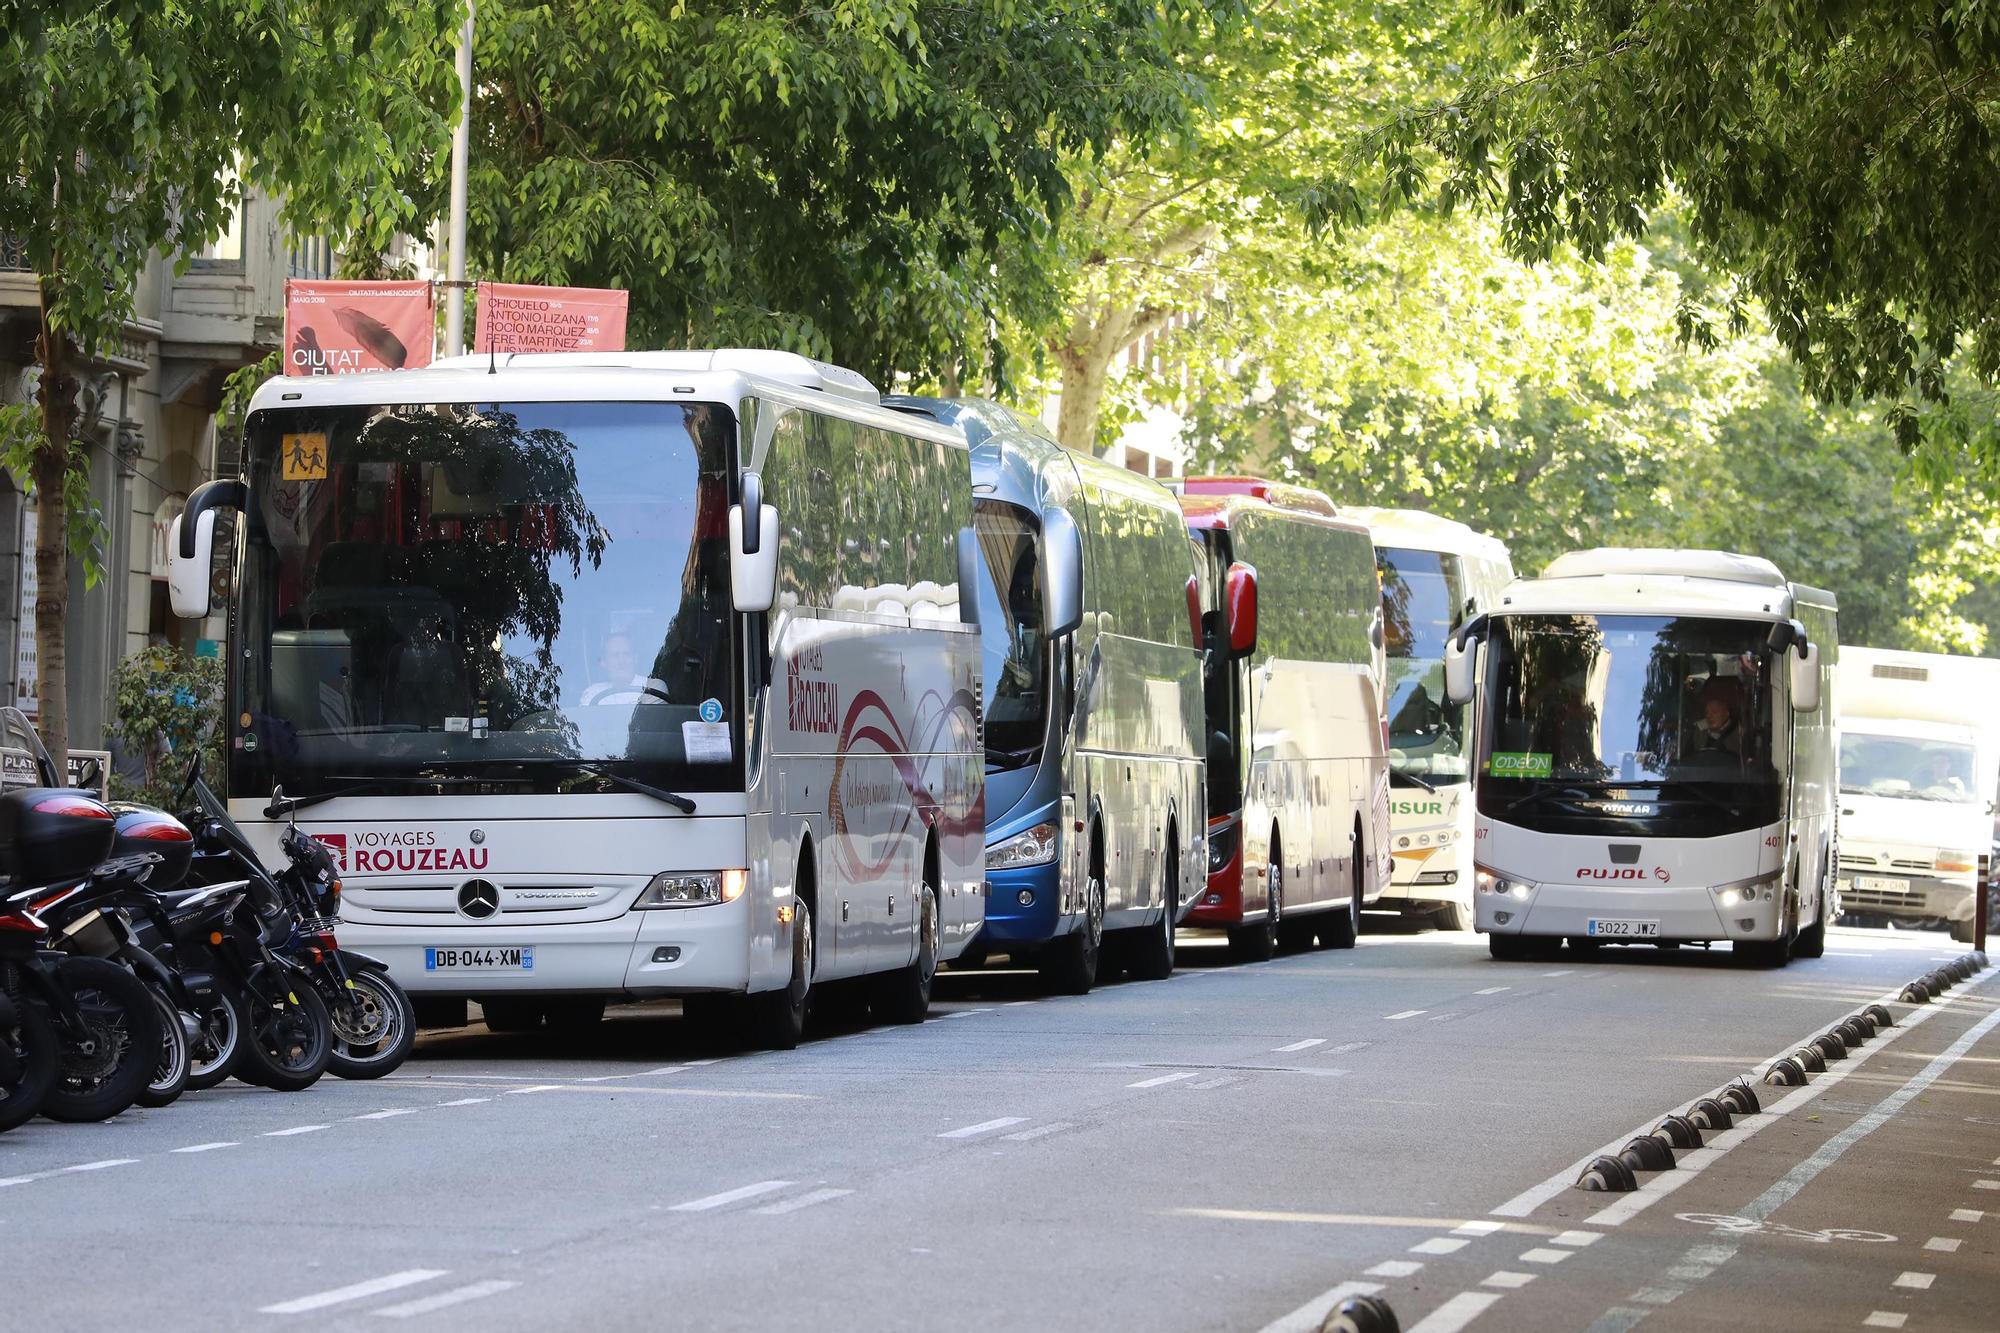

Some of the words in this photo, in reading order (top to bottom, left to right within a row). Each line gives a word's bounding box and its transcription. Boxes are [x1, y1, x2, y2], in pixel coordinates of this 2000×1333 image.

[488, 298, 549, 311] CHICUELO
[487, 310, 541, 322] ANTONIO
[543, 313, 587, 325] LIZANA
[486, 320, 525, 333] ROCÍO
[526, 323, 586, 337] MÁRQUEZ
[485, 333, 516, 345] PERE
[518, 335, 579, 349] MARTÍNEZ
[292, 349, 364, 366] CIUTAT
[705, 706, 717, 720] 5
[799, 679, 838, 735] ROUZEAU
[1494, 755, 1549, 769] ODEON
[1391, 801, 1442, 815] ISUR
[354, 831, 435, 847] VOYAGES
[1765, 836, 1781, 848] 407
[355, 847, 488, 872] ROUZEAU
[1576, 868, 1648, 879] PUJOL
[514, 890, 599, 899] TOURISMO
[1597, 922, 1629, 934] 5022
[1634, 923, 1657, 935] JWZ
[436, 949, 520, 967] DB-044-XM
